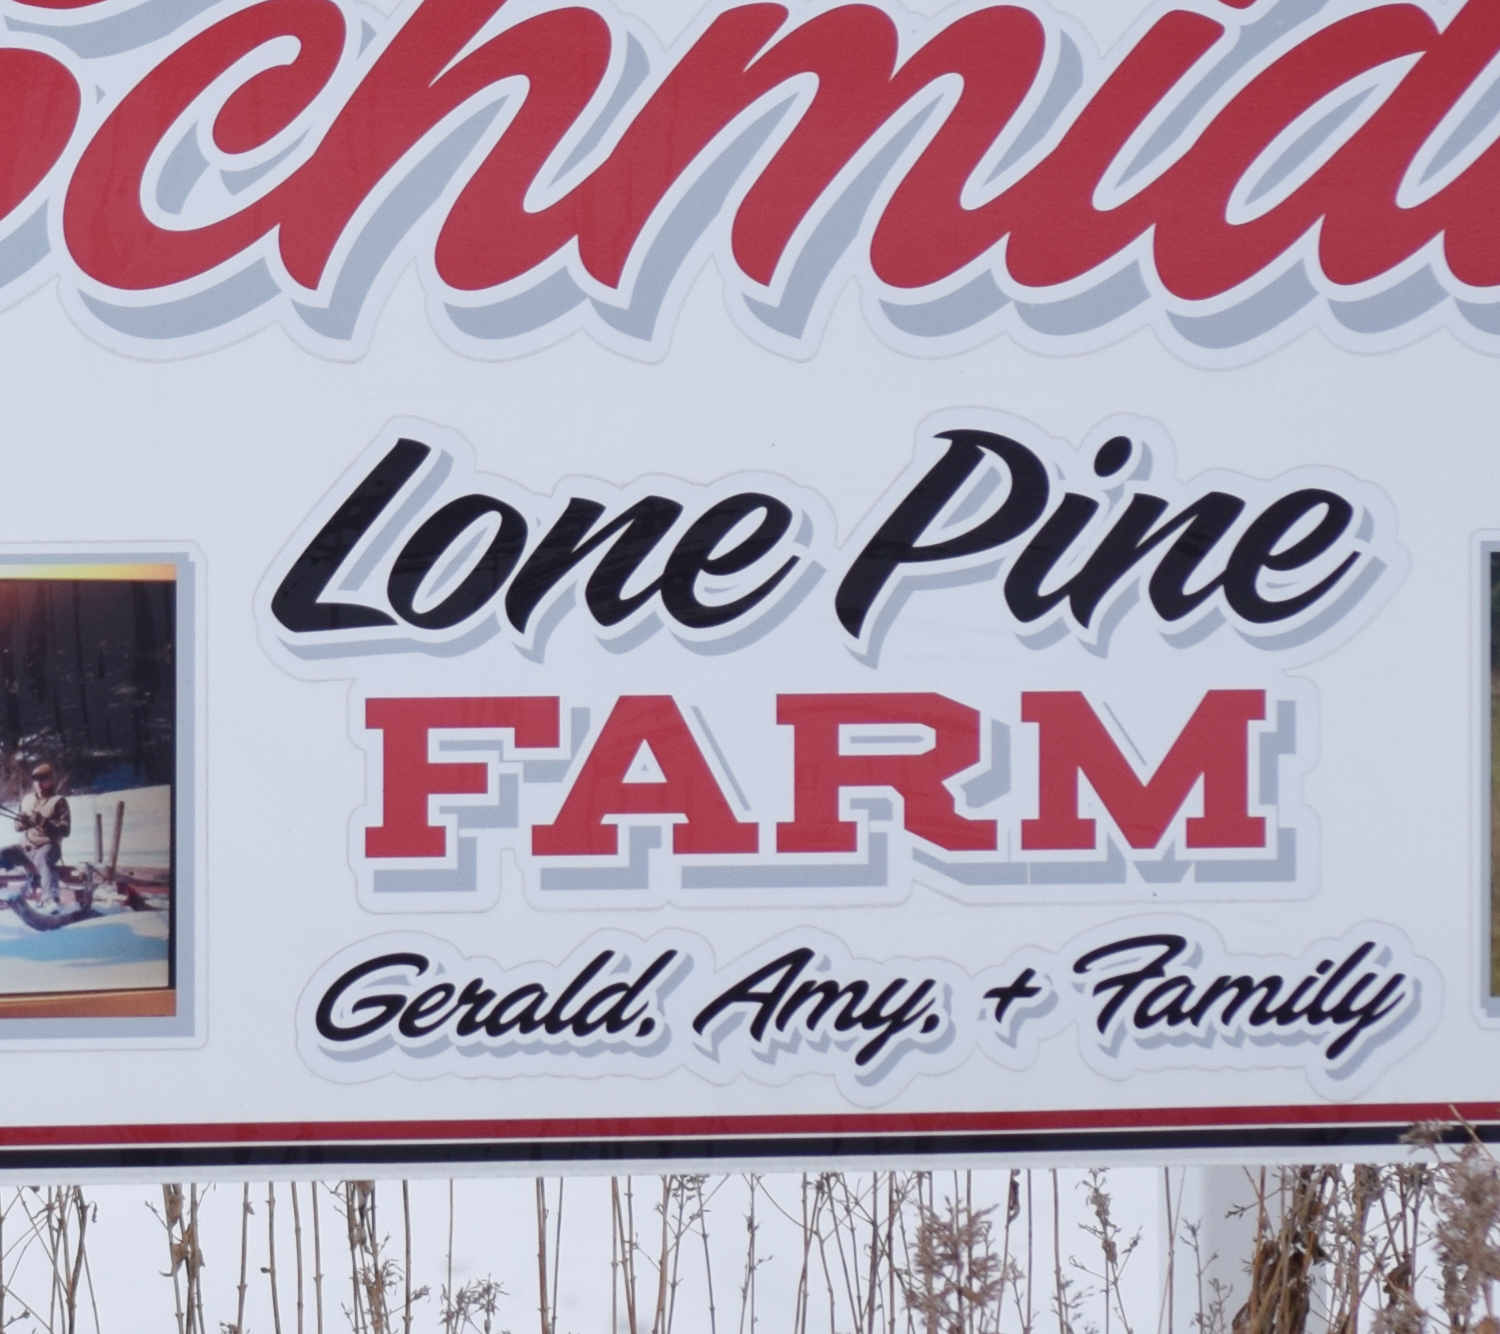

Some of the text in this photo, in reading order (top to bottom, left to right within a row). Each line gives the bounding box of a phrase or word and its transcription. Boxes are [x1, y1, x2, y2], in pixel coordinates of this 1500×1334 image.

[271, 429, 1358, 637] Lone Pine
[365, 689, 1265, 858] FARM
[315, 934, 1407, 1065] Gerald, Amy, + Family
